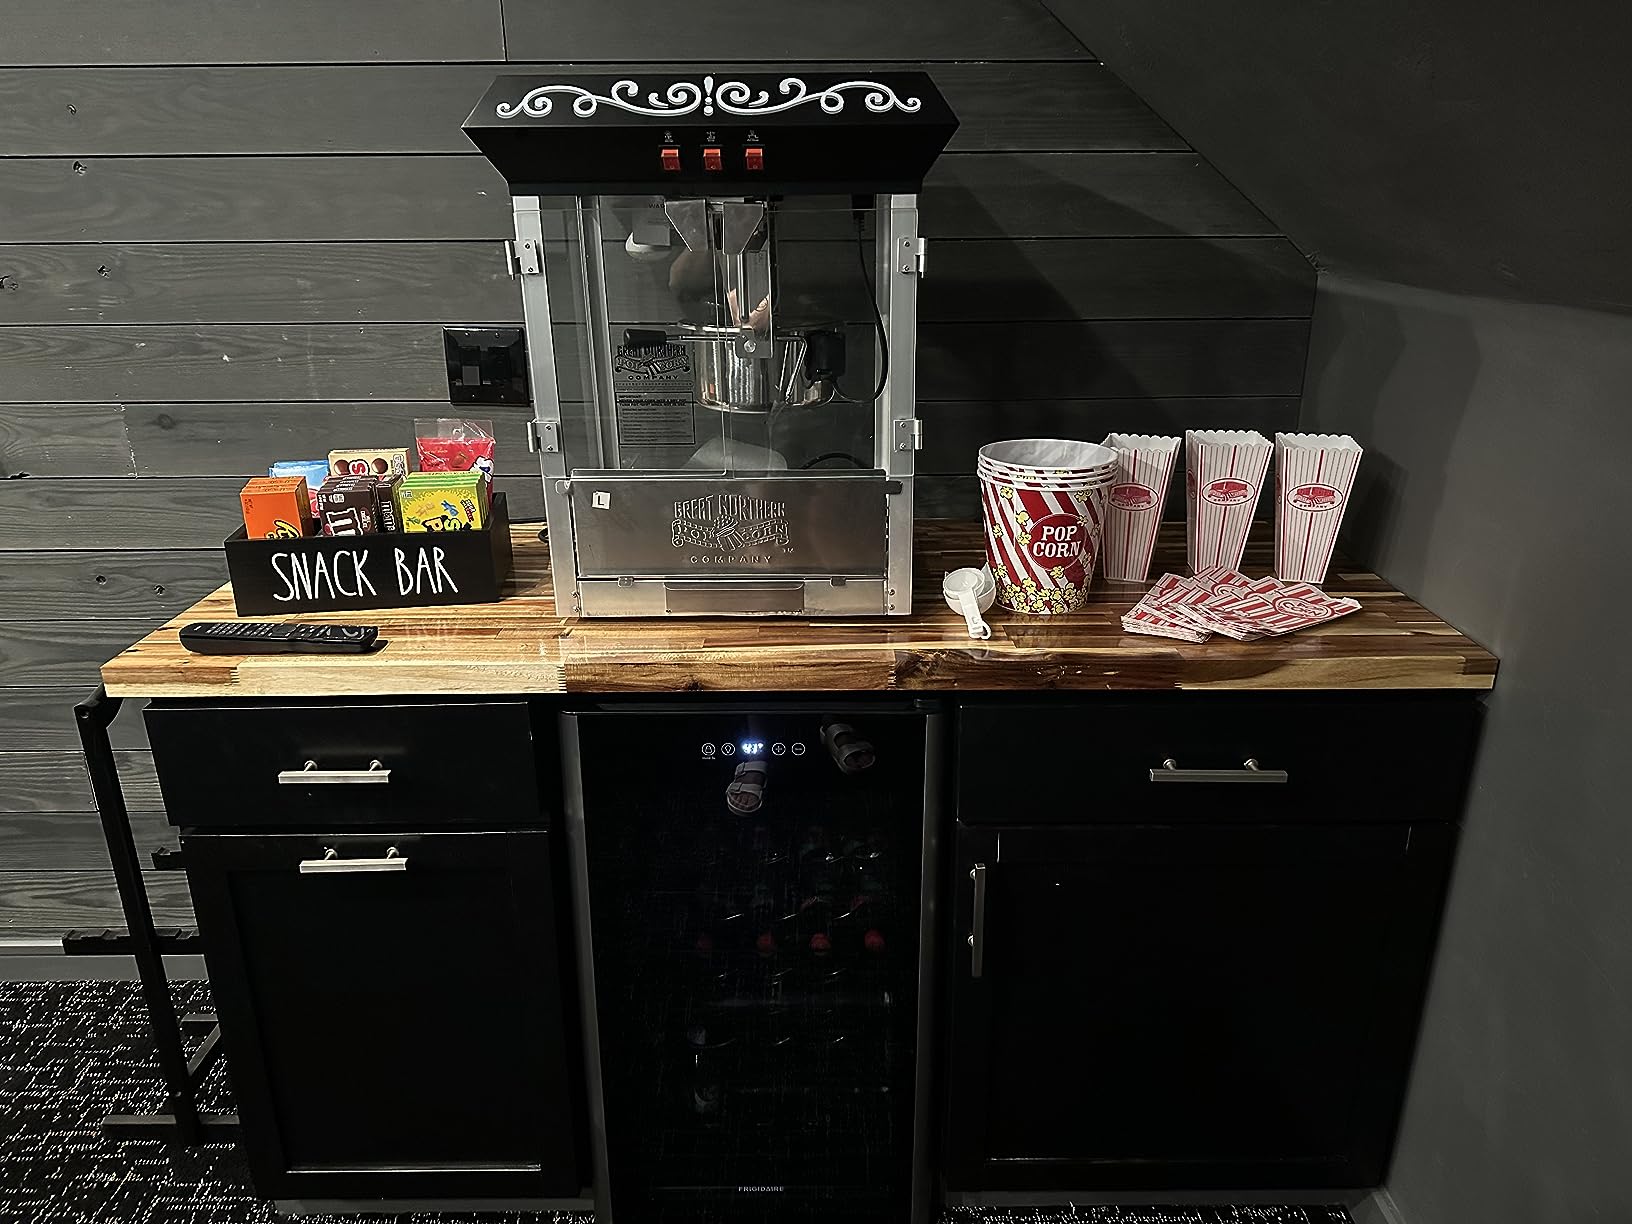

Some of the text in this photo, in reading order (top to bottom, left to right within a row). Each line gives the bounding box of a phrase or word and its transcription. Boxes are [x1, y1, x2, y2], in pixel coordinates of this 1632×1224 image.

[674, 494, 786, 521] GREAT NORTHERN
[1040, 525, 1078, 542] POP
[1032, 540, 1082, 558] CORN
[690, 555, 772, 564] COMPANY
[271, 546, 459, 602] SNACK BAR
